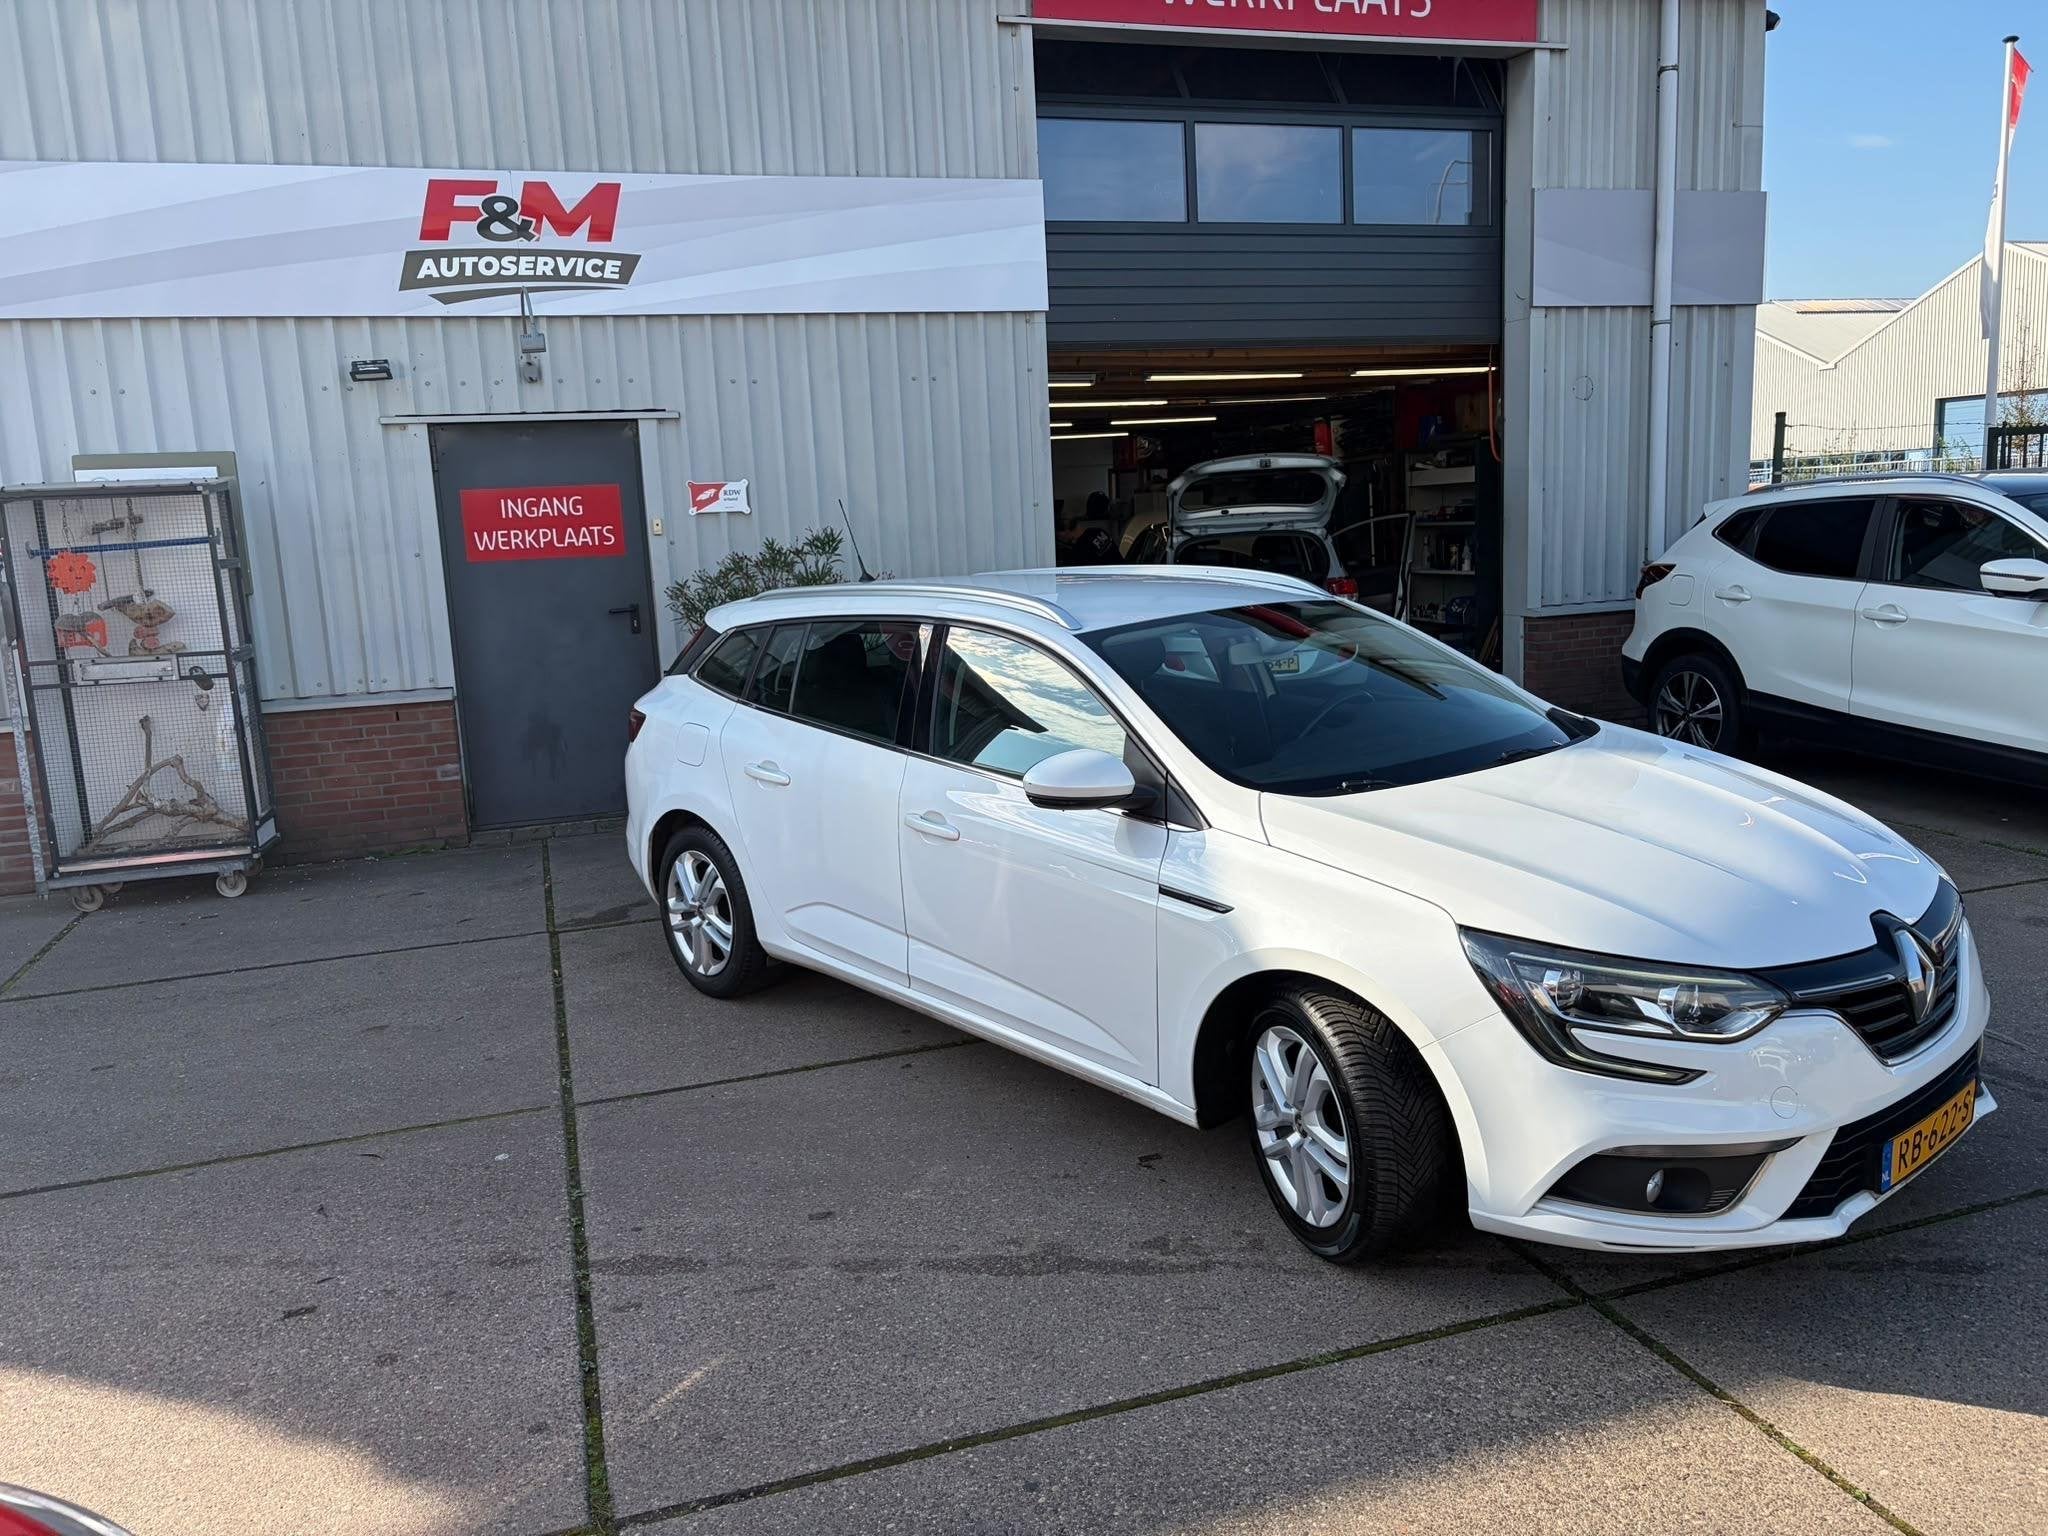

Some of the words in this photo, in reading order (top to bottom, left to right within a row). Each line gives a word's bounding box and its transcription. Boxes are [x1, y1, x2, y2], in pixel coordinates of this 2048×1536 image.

[419, 179, 622, 242] F&M
[416, 255, 622, 279] AUTOSERVICE
[500, 496, 583, 519] INGANG
[474, 526, 615, 551] WERKPLAATS
[1881, 1171, 1890, 1183] NL
[1898, 1089, 1971, 1174] RB-622-S
